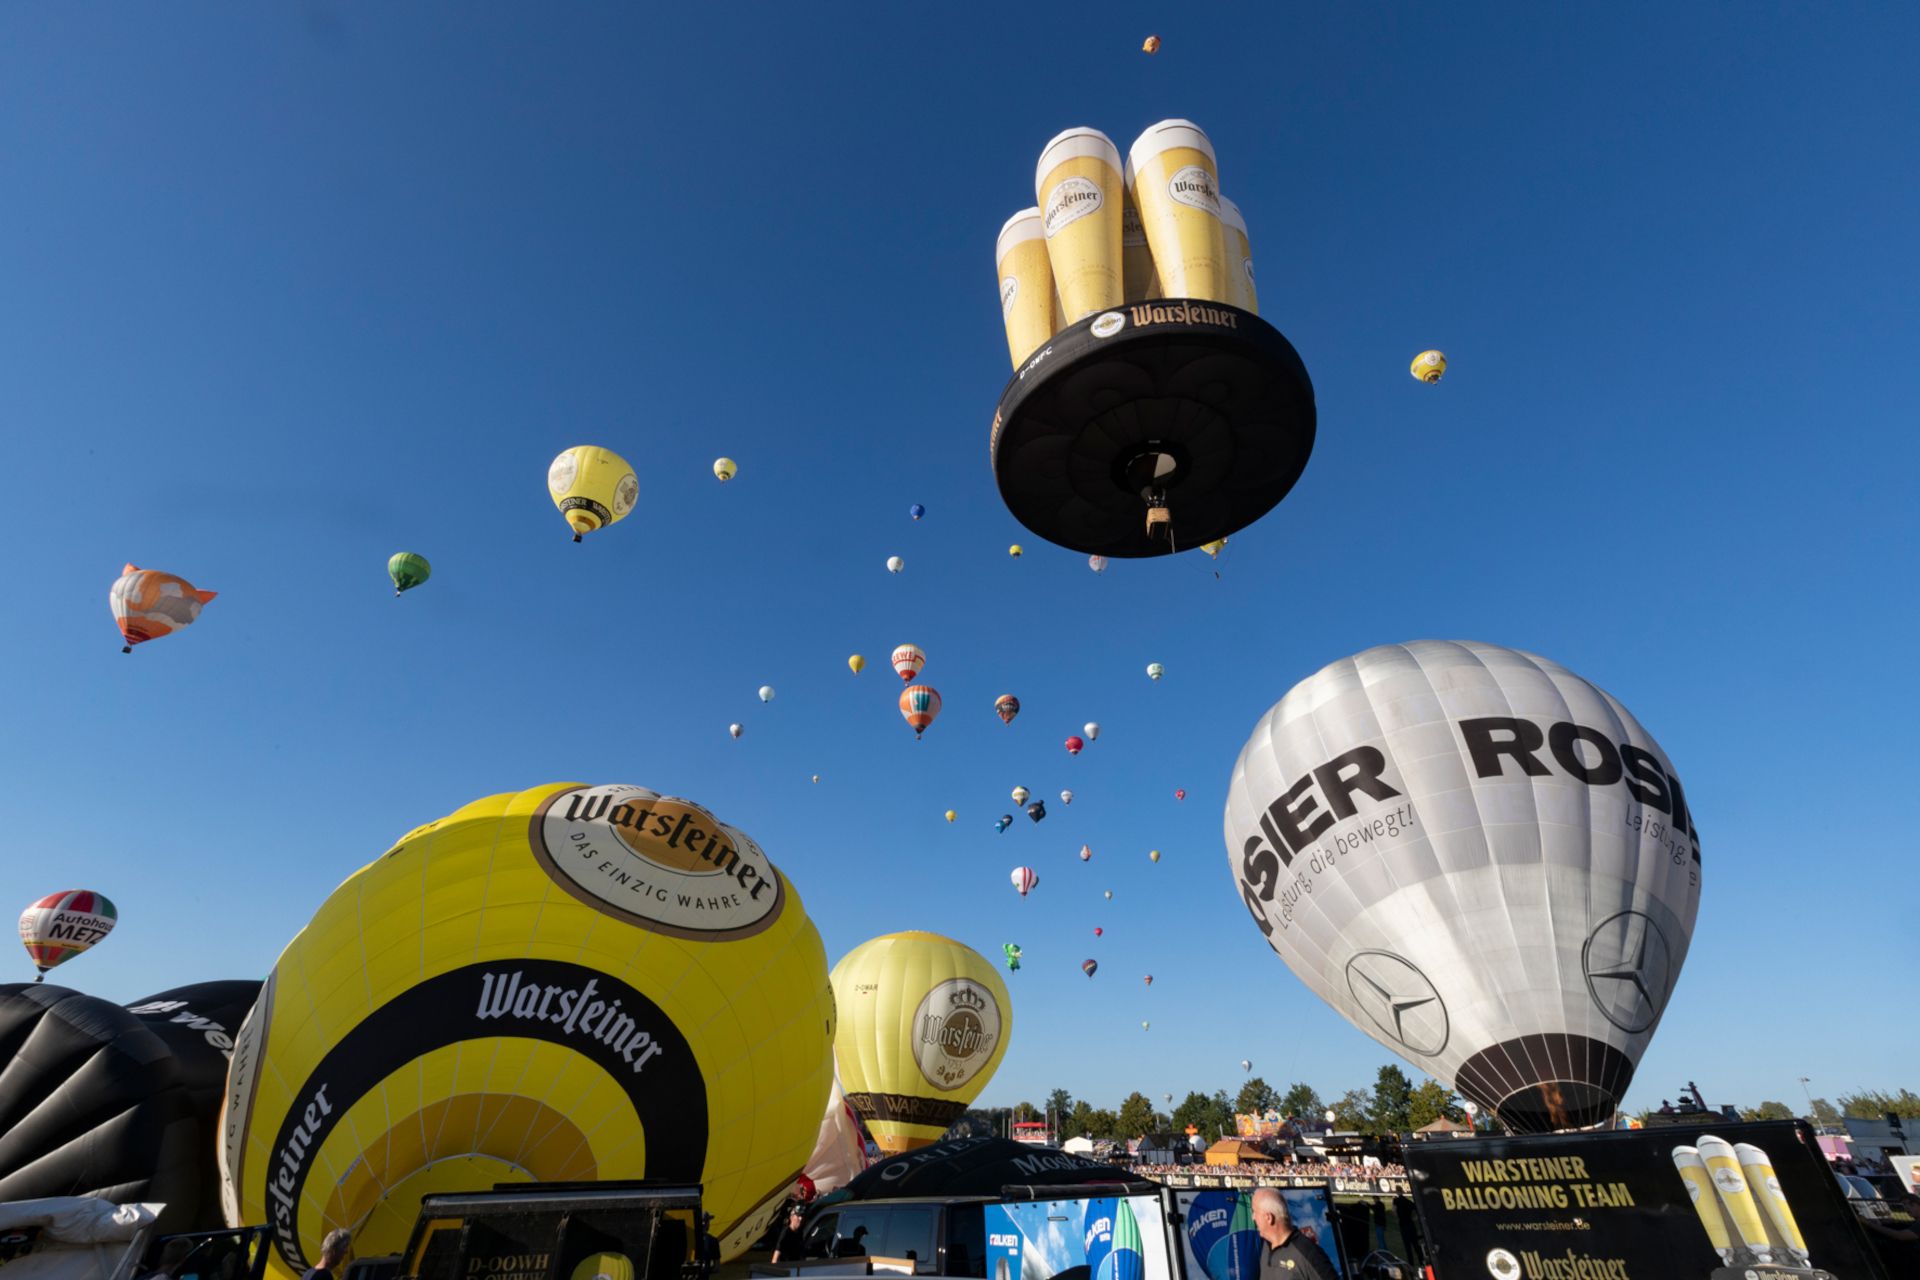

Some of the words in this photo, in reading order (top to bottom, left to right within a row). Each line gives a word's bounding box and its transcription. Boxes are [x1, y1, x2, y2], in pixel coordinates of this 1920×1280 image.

[1131, 301, 1238, 328] Warsteiner
[1458, 716, 1701, 866] ROSI
[564, 794, 771, 901] Warsteiner
[571, 832, 598, 860] DAS
[597, 860, 669, 902] EINZIG
[677, 893, 741, 911] WAHRE
[1274, 871, 1313, 930] Lestung,
[1310, 848, 1336, 875] die
[1337, 803, 1414, 856] bewegt!
[48, 924, 108, 945] METZ
[475, 970, 664, 1073] Warsteiner
[1441, 1185, 1568, 1210] BALLOONING
[1570, 1183, 1635, 1208] TEAM
[1461, 1156, 1590, 1183] WARSTEINER
[1520, 1248, 1630, 1280] Warsteiner
